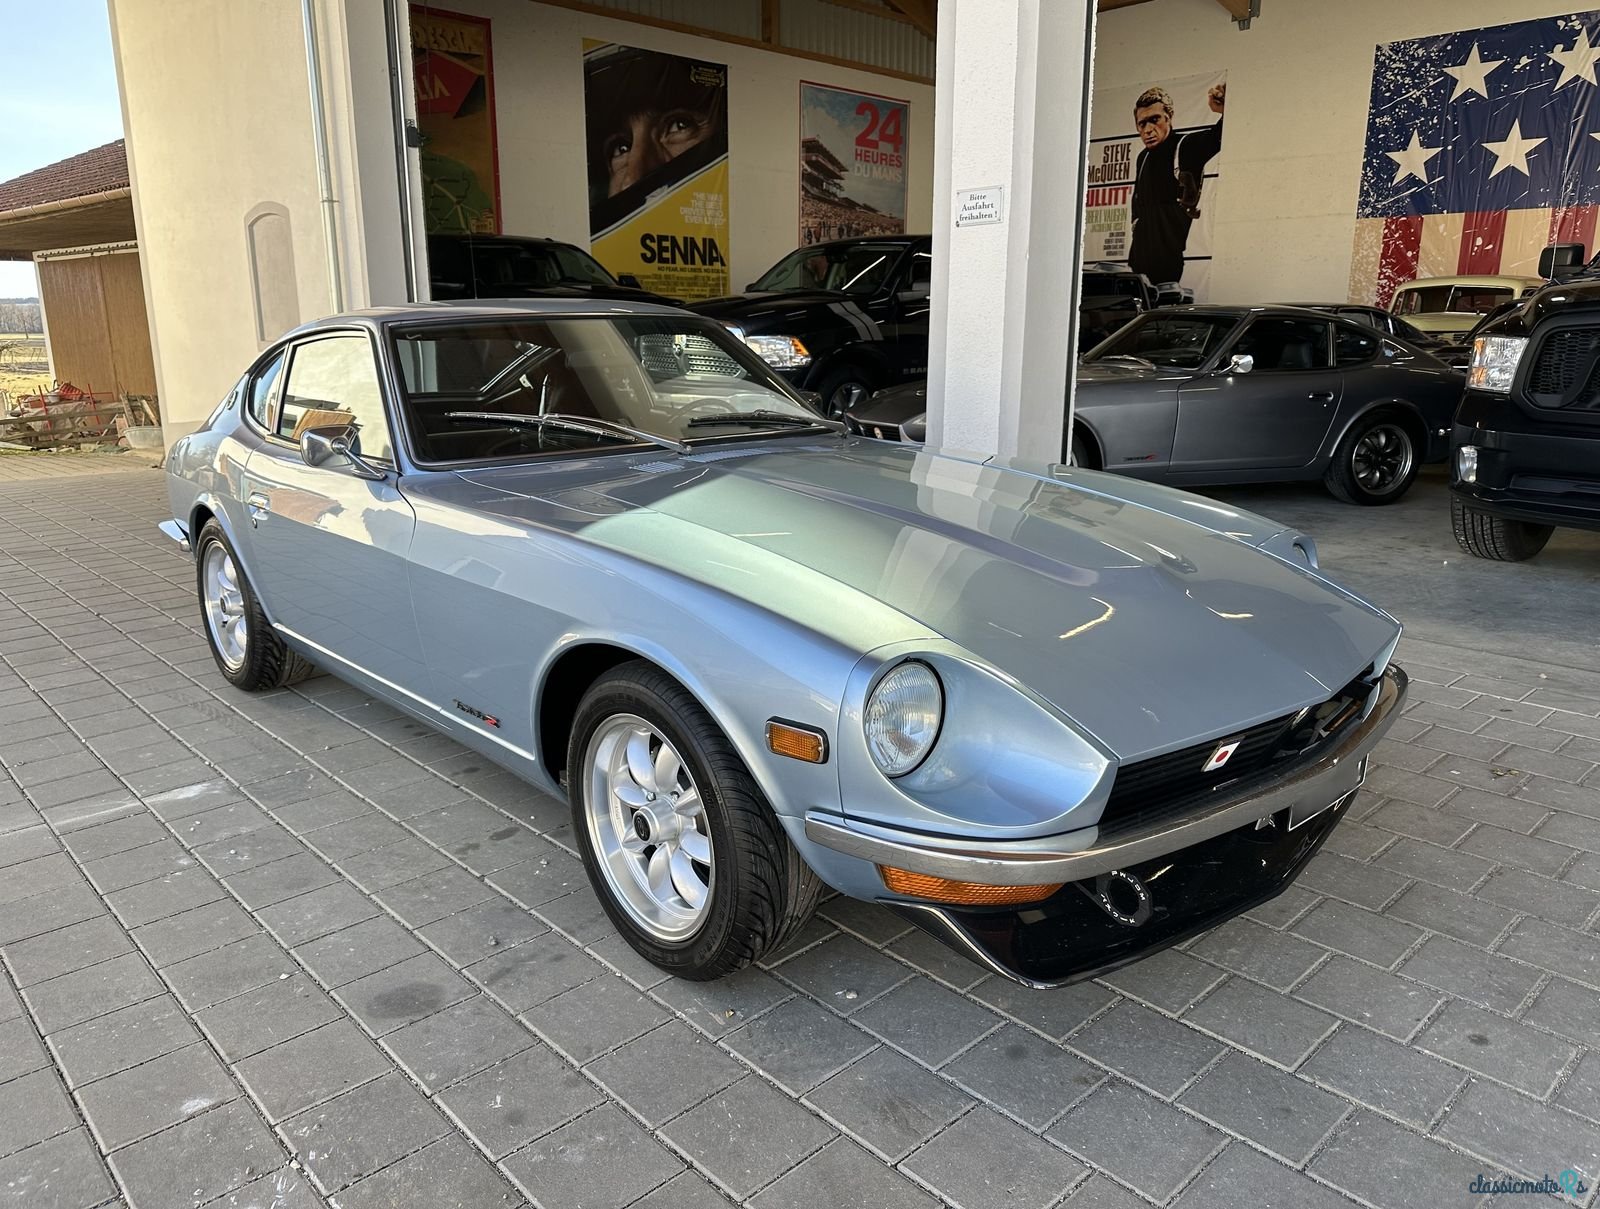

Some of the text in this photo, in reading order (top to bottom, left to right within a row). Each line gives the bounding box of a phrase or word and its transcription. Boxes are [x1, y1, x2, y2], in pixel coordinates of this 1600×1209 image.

[855, 101, 904, 153] 24
[855, 148, 903, 169] HEURES
[1103, 142, 1131, 164] STEVE
[855, 164, 903, 182] DU MANS
[1087, 161, 1131, 184] McQUEEN
[961, 201, 994, 211] Ausfahrt
[969, 193, 987, 201] Bitte
[959, 212, 993, 221] freihalten
[640, 232, 727, 267] SENNA
